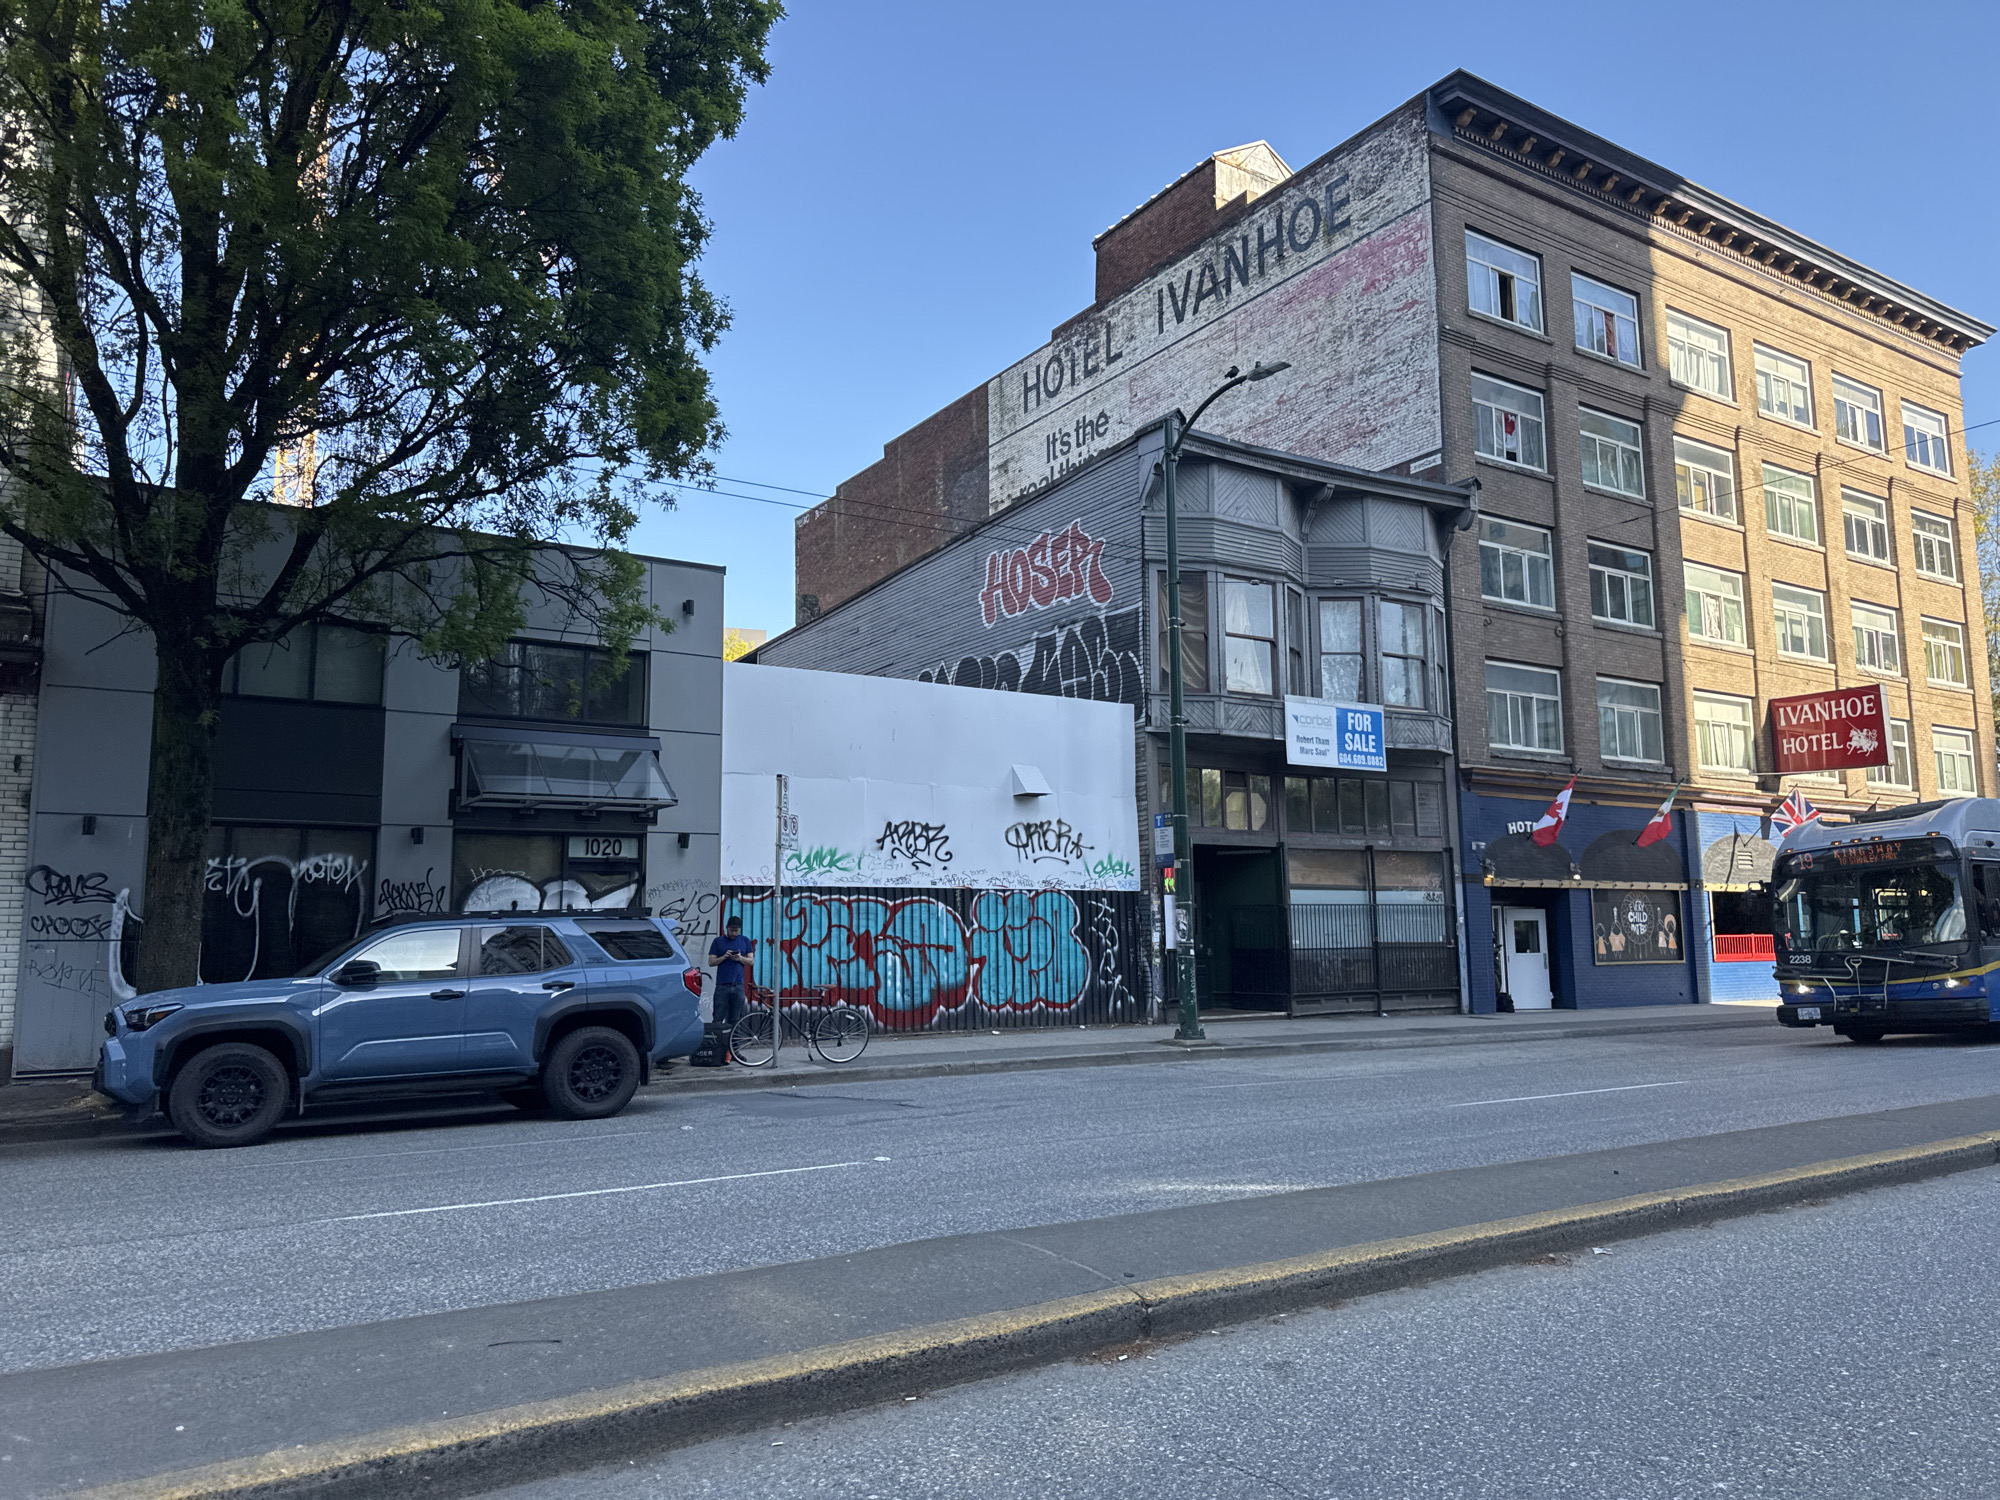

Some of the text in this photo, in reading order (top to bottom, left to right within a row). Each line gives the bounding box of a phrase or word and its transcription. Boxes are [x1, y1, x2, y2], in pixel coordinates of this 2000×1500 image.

[1023, 172, 1352, 414] HOTEL IVANHOE
[1046, 410, 1109, 464] It's the
[1779, 695, 1877, 727] IVANHOE
[1299, 714, 1332, 727] corbel
[1347, 712, 1372, 732] FOR
[1296, 735, 1330, 746] Robert Tham
[1344, 732, 1377, 753] SALE
[1782, 732, 1844, 755] HOTEL
[1299, 746, 1314, 756] Marc
[1507, 821, 1538, 834] HOT
[584, 838, 622, 856] 1020
[1833, 842, 1902, 859] KINGSWAY
[1798, 853, 1814, 870] 19
[1628, 911, 1648, 923] CHILD
[1789, 955, 1812, 964] 2238
